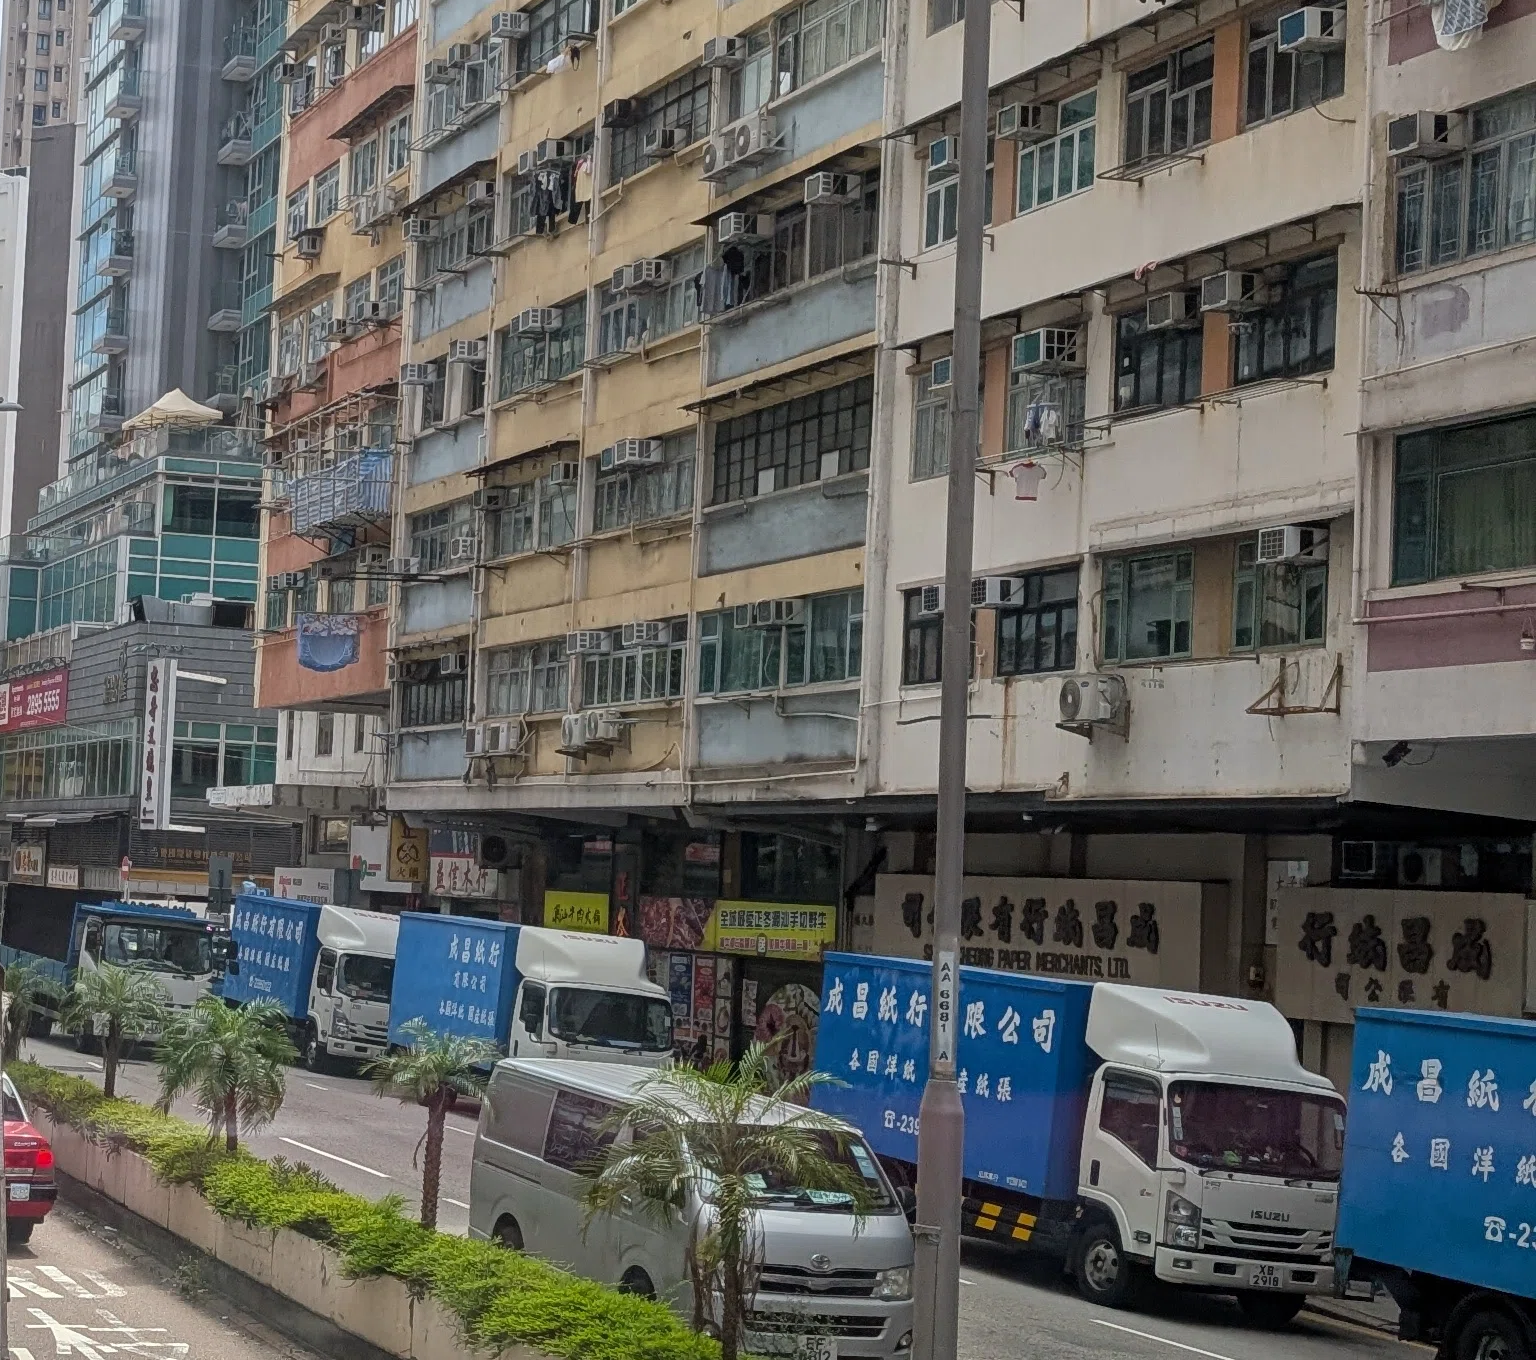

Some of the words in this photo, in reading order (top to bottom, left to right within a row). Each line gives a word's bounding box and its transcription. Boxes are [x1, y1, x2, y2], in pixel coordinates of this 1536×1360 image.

[939, 990, 950, 1033] 6681
[1163, 996, 1249, 1012] ISUZU
[824, 976, 1056, 1053] 成昌紙行限公司
[939, 1050, 948, 1061] A
[1250, 1209, 1290, 1223] ISUZU
